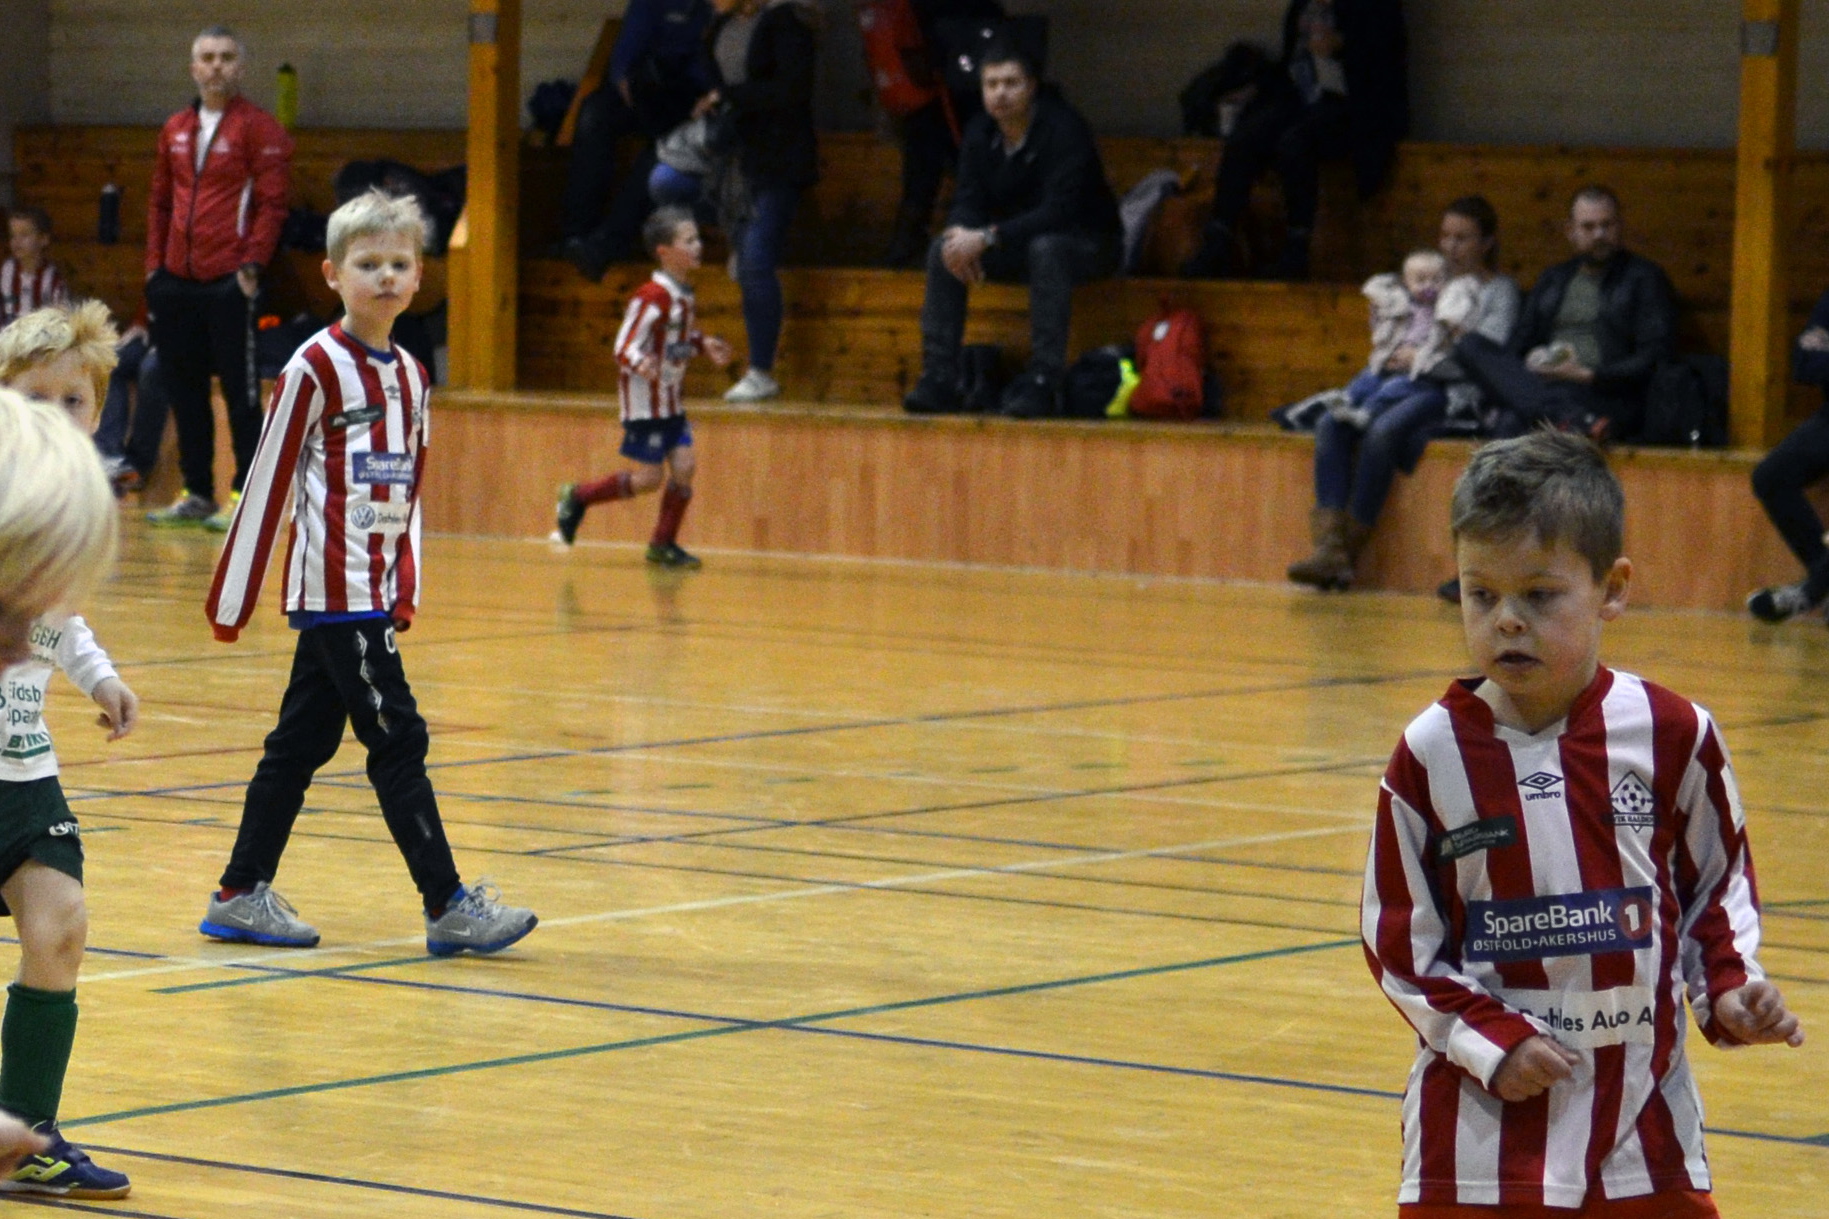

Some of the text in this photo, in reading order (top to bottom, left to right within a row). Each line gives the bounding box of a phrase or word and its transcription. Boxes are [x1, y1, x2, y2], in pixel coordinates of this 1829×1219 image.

[1525, 790, 1561, 801] umbro
[1483, 900, 1640, 938] SpareBank 1
[1591, 1010, 1630, 1030] Auo
